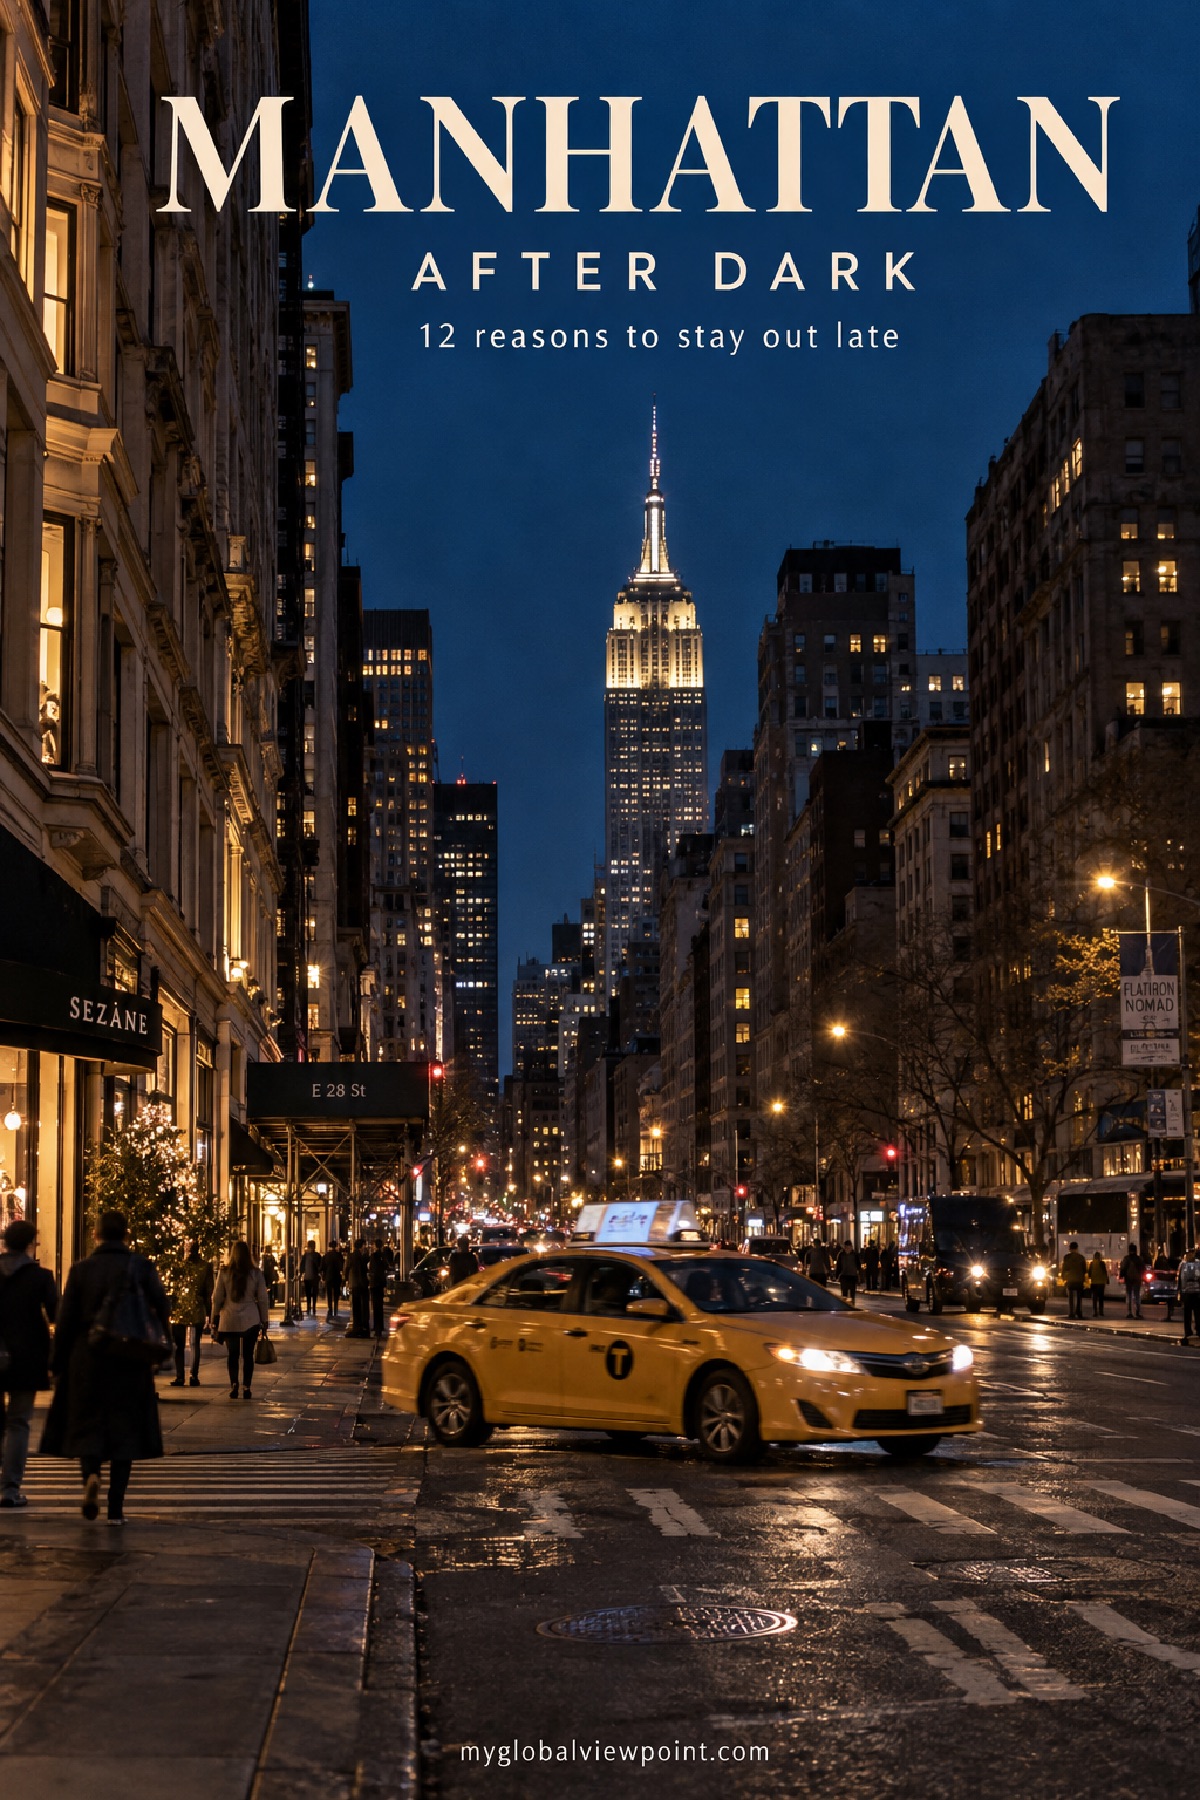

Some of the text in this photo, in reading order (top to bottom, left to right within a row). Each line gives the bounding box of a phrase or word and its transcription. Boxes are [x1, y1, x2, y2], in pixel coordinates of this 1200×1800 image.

[1123, 981, 1175, 996] FLATIRON
[1125, 998, 1174, 1012] NOMAD
[312, 1083, 367, 1097] E 28 St
[611, 1348, 628, 1376] T
